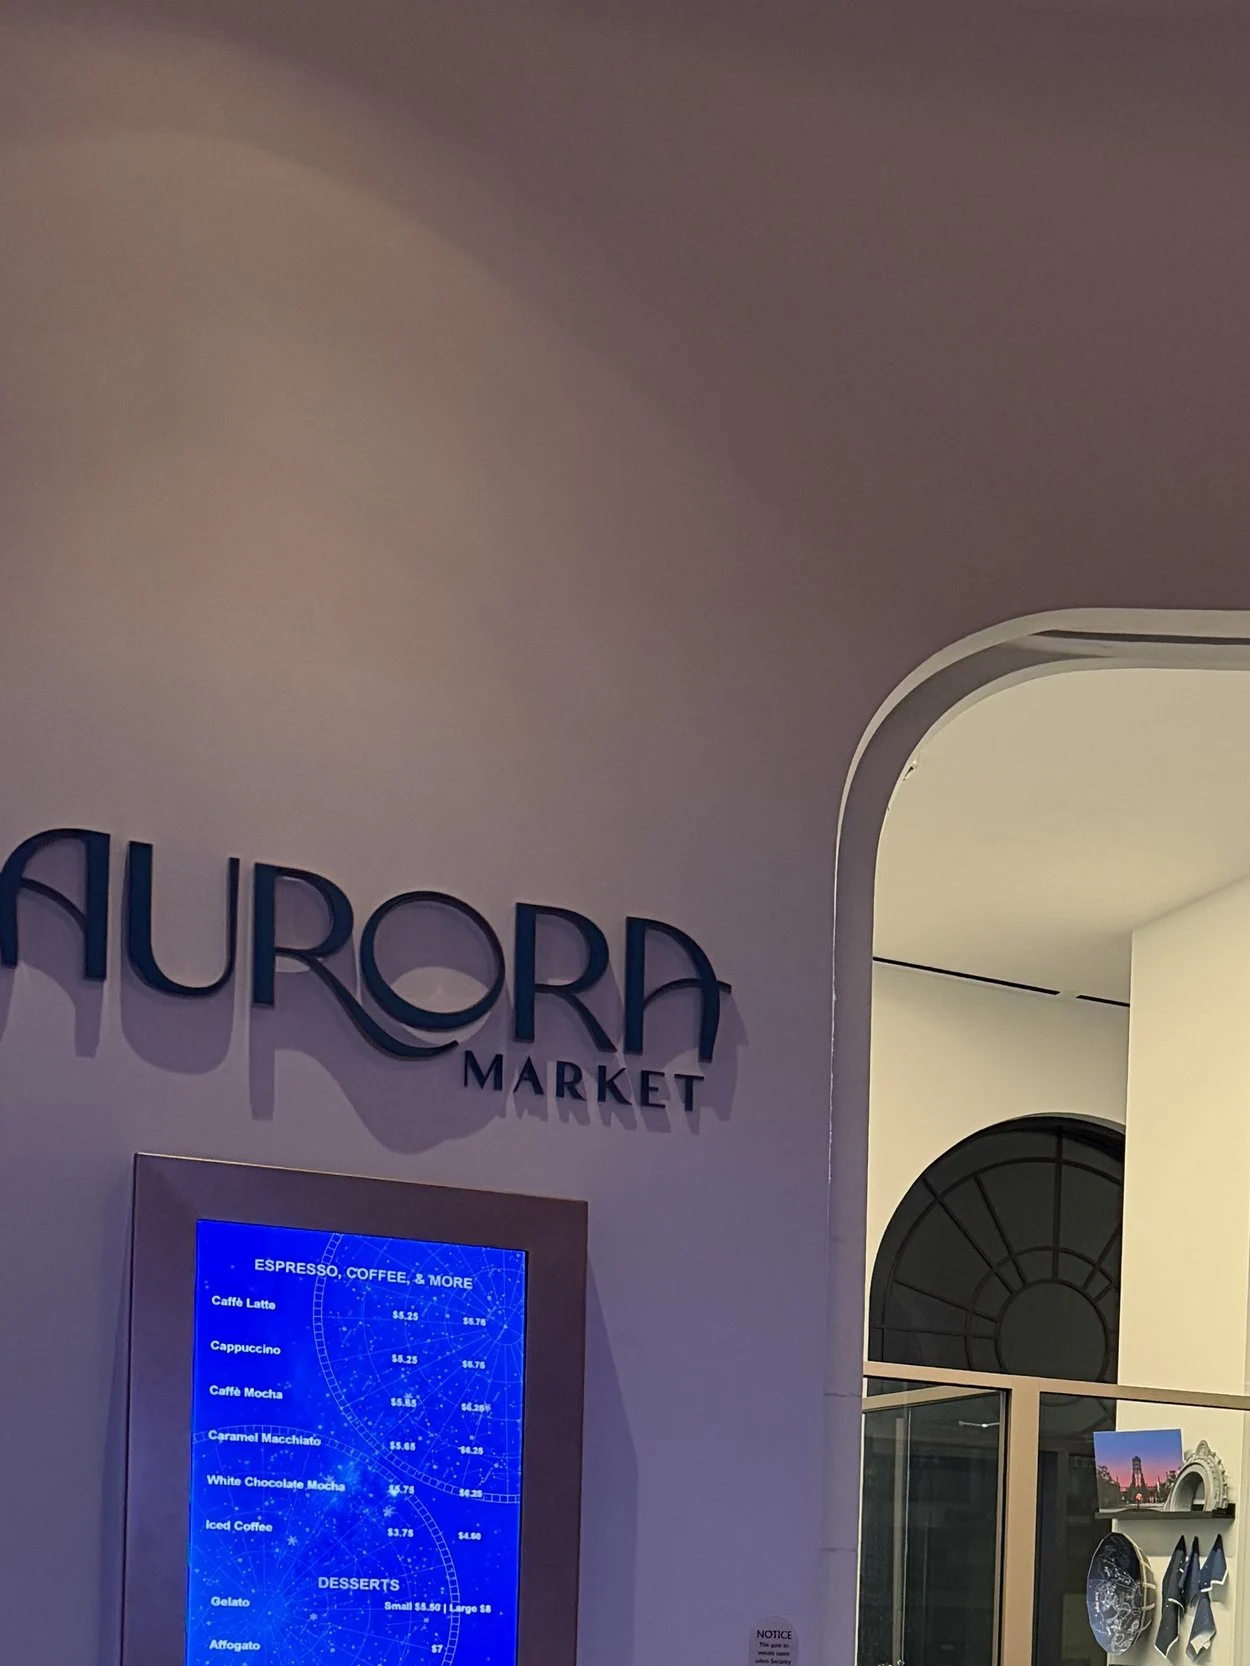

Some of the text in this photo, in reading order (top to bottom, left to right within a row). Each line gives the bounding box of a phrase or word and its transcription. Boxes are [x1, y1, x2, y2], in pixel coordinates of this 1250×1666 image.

[0, 828, 731, 1062] AURORA
[463, 1050, 705, 1112] MARKET
[254, 1258, 473, 1289] ESPRESSO, COFFEE, & MORE
[211, 1295, 243, 1308] Caffè
[246, 1298, 276, 1310] Latte
[210, 1340, 281, 1356] Cappuccino
[209, 1385, 241, 1397] Caffè
[244, 1387, 283, 1400] Mocha
[208, 1430, 258, 1443] Caramel
[261, 1432, 321, 1446] Macchiato
[207, 1474, 241, 1486] White
[244, 1476, 304, 1490] Chocolate
[307, 1480, 345, 1492] Mocha
[205, 1520, 231, 1532] Iced
[234, 1521, 273, 1533] Coffee
[318, 1576, 400, 1591] DESSERTS
[211, 1596, 250, 1609] Gelato
[384, 1601, 413, 1611] Small
[449, 1603, 477, 1615] Large
[757, 1630, 792, 1639] NOTICE
[209, 1640, 443, 1654] Affogato $7
